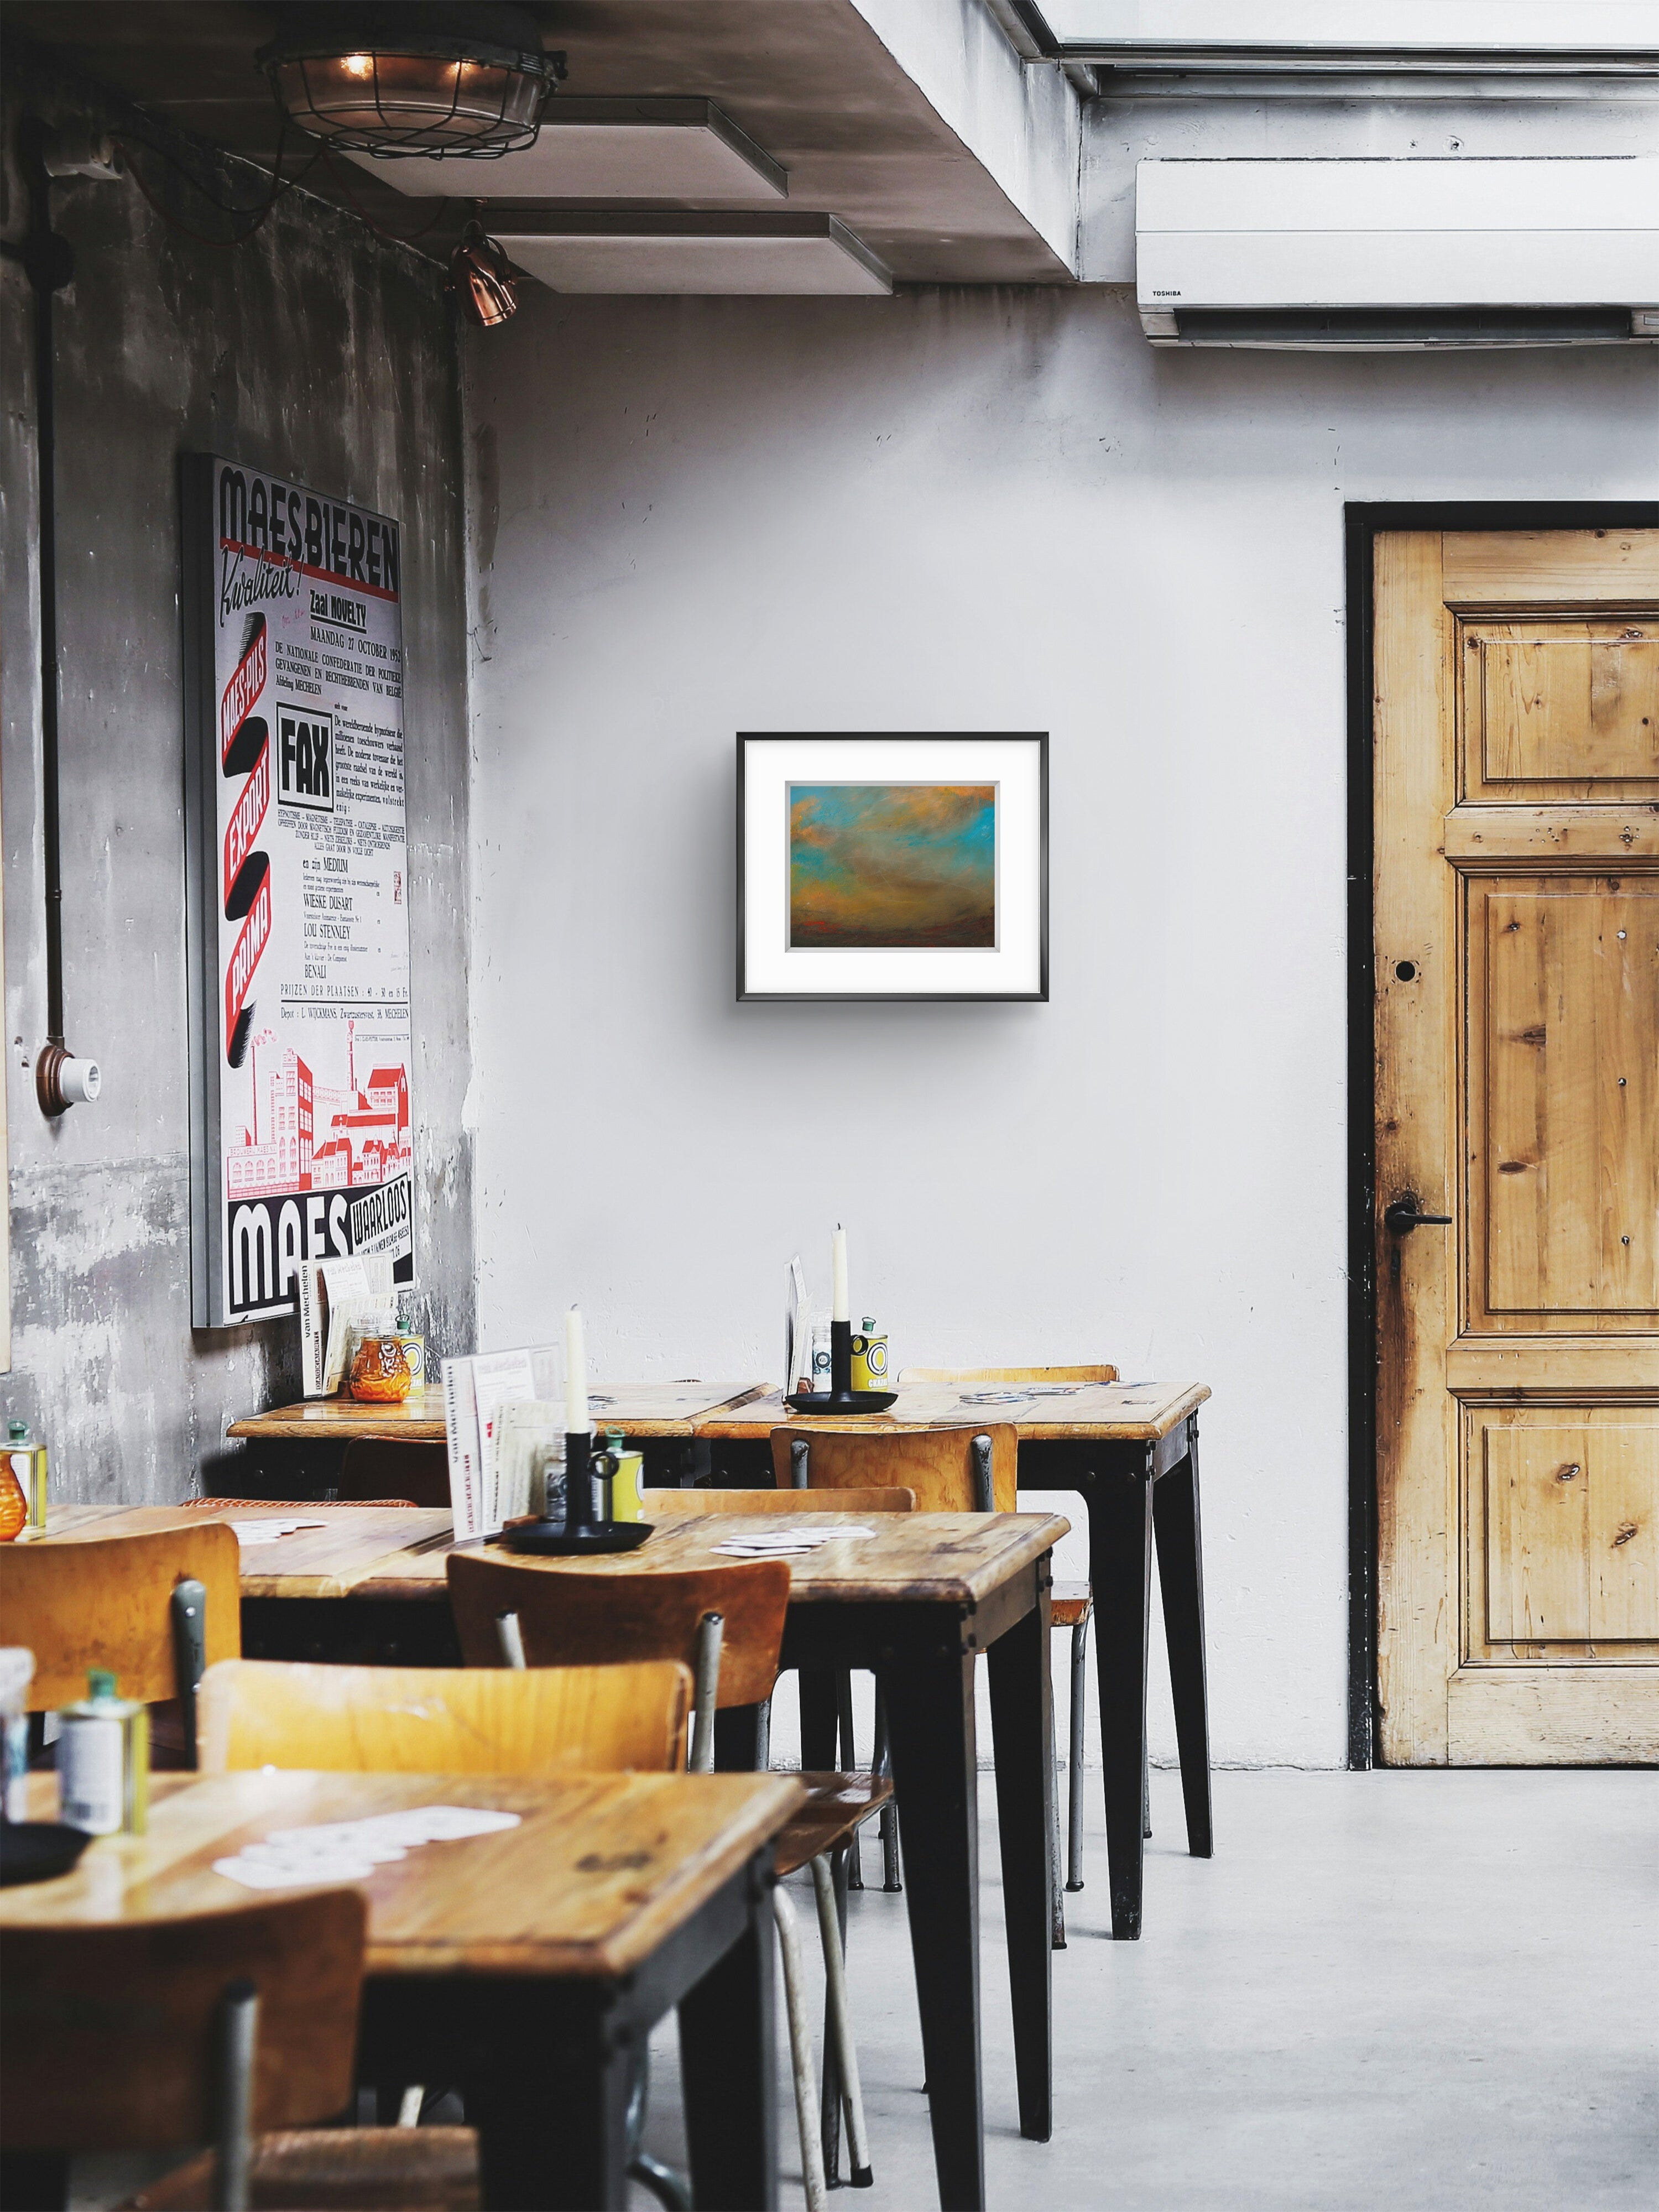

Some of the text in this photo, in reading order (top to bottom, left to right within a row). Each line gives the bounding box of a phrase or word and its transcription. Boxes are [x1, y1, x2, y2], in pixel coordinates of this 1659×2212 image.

[220, 466, 399, 592] MAESBIEREN
[220, 545, 304, 628] Kwaliteit!
[309, 589, 328, 616] Zaal
[310, 627, 400, 662] MAANDAG 27 OCTOBER 1952
[275, 642, 401, 684] DE NATIONALE CONFEDERATIE DER POLITIEKE
[275, 658, 311, 677] GEVANGENEN
[315, 667, 321, 680] EN
[326, 670, 369, 691] RECHTHEBBENDEN
[373, 681, 382, 694] VAN
[295, 679, 321, 696] MECHELEN
[335, 715, 341, 726] De
[281, 718, 330, 797] FAX
[348, 746, 353, 757] De
[355, 749, 371, 760] moderne
[378, 766, 382, 775] de
[385, 767, 397, 778] wereld
[229, 747, 267, 880] EXPORT
[383, 794, 404, 807] volstrekt
[303, 860, 309, 868] en
[324, 857, 347, 873] MEDIUM
[304, 894, 352, 910] WIESKE DUSART
[304, 923, 351, 939] LOU STENNLEY
[231, 886, 268, 1016] PRIMA
[305, 964, 326, 978] BENALI
[281, 984, 306, 997] PRIJZEN
[311, 985, 323, 996] DER
[327, 986, 358, 997] PLAATSEN
[281, 1006, 294, 1020] Depot
[385, 1008, 408, 1019] MECHELEN
[353, 1180, 408, 1245] WAARLOOS
[232, 1193, 350, 1306] MAES
[301, 1265, 310, 1317] Mechelen
